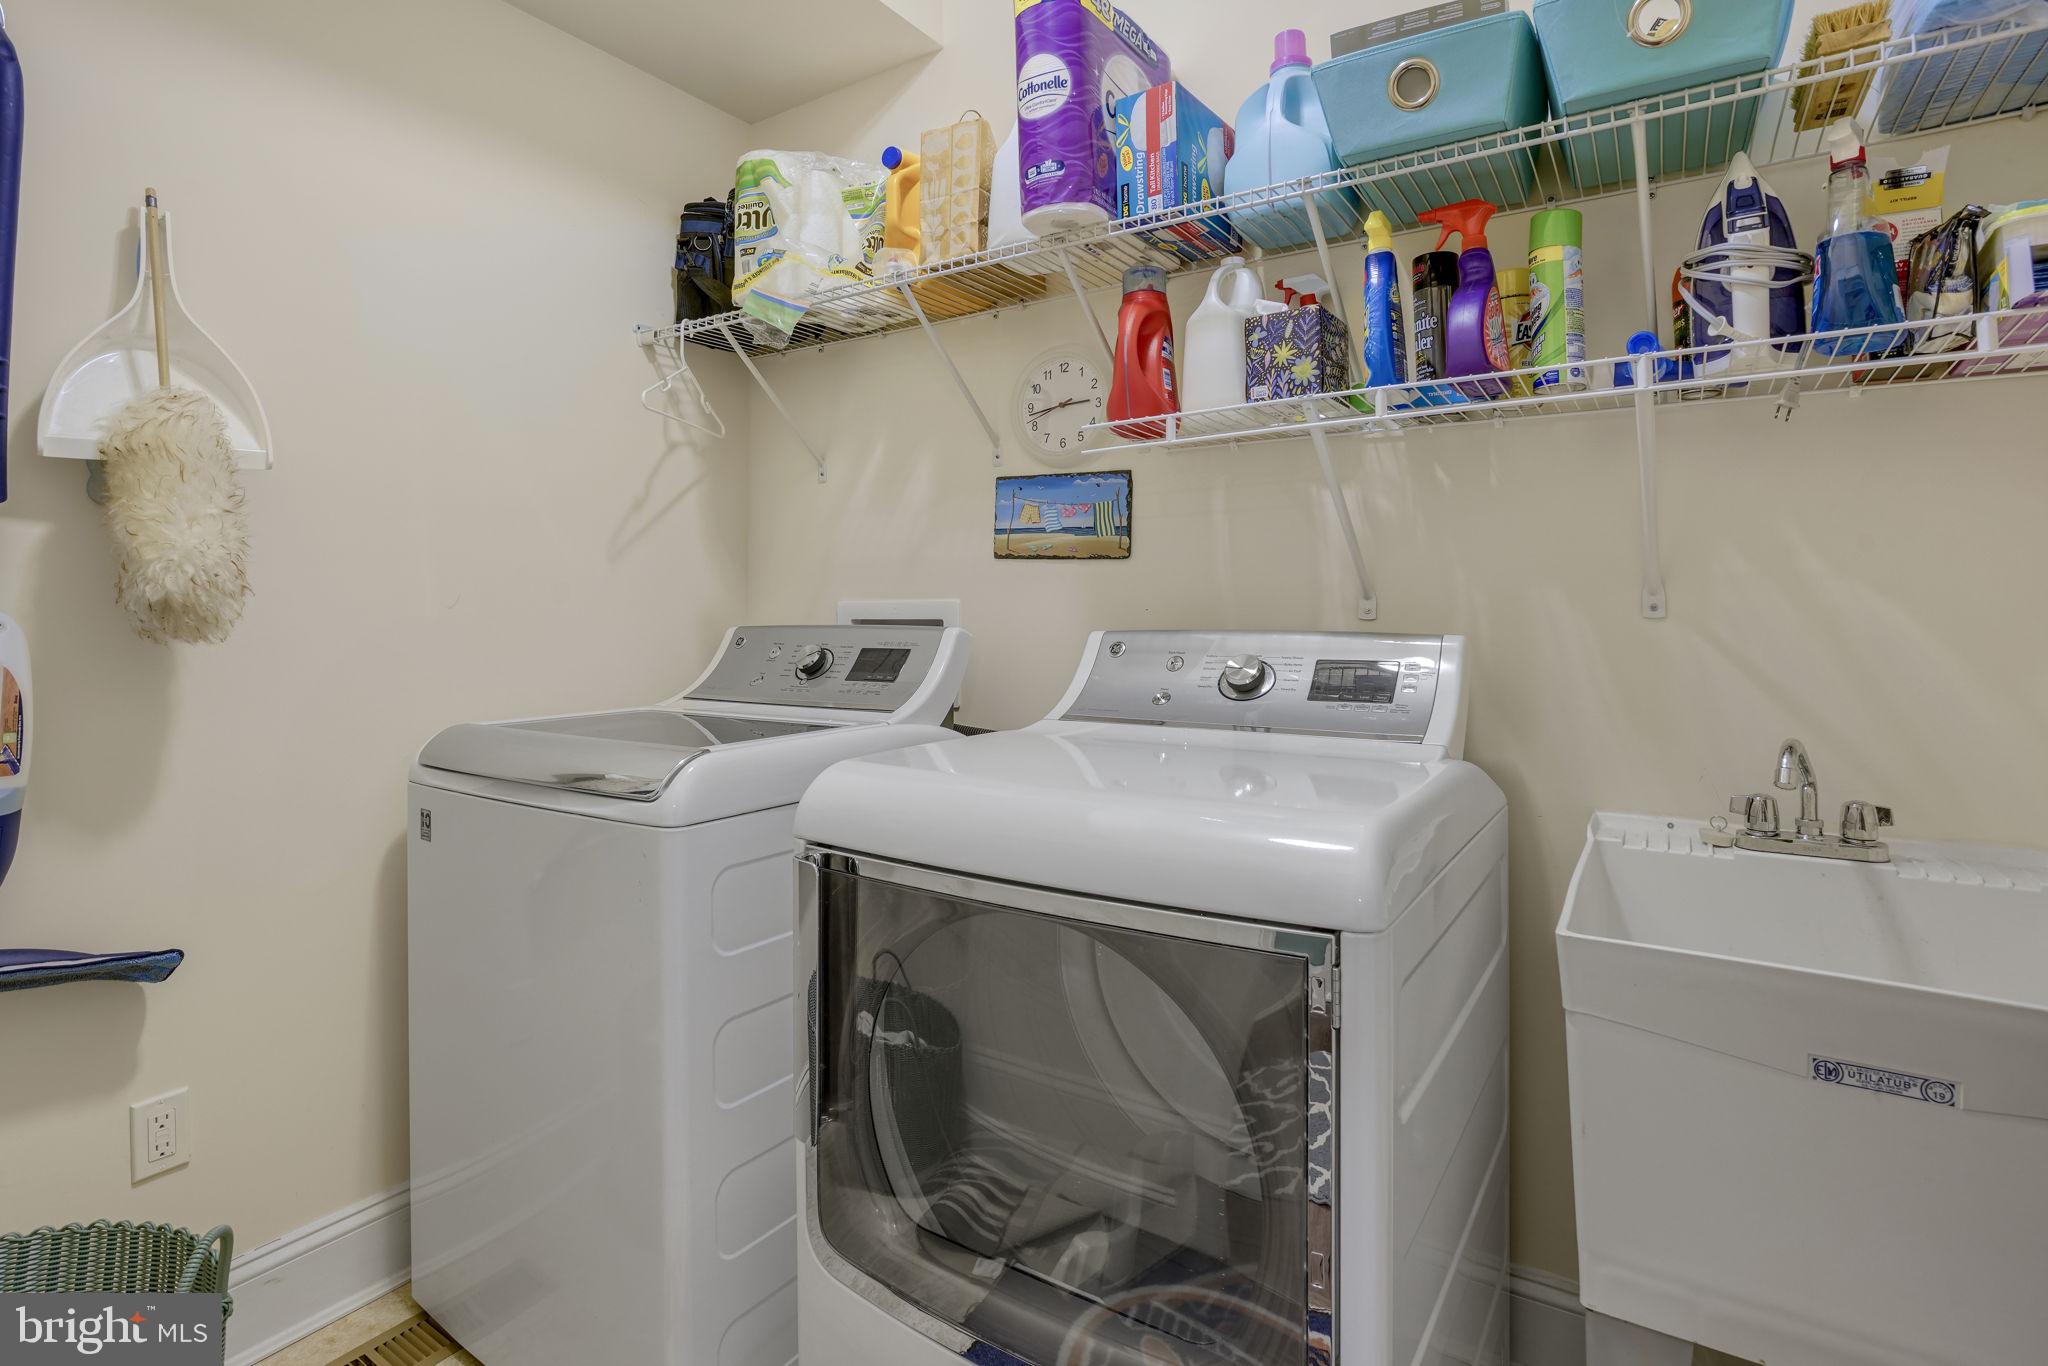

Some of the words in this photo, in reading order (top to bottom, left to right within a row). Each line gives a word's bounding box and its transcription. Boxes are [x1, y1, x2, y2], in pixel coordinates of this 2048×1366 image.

[1113, 10, 1146, 46] MEGA
[1018, 75, 1068, 102] Cottonelle
[1134, 152, 1146, 215] Drawstring
[1150, 198, 1157, 210] 80
[1059, 362, 1070, 373] 12
[1080, 366, 1084, 377] 1
[1043, 370, 1052, 380] 11
[1031, 384, 1041, 394] 10
[1091, 378, 1098, 389] 2
[1027, 402, 1034, 413] 9
[1095, 397, 1102, 408] 3
[1031, 421, 1038, 431] 8
[1089, 416, 1096, 425] 4
[1044, 433, 1050, 443] 7
[1077, 431, 1084, 441] 5
[1060, 438, 1067, 448] 6
[1847, 1070, 1912, 1090] UTILATUB
[1933, 1090, 1946, 1101] 19
